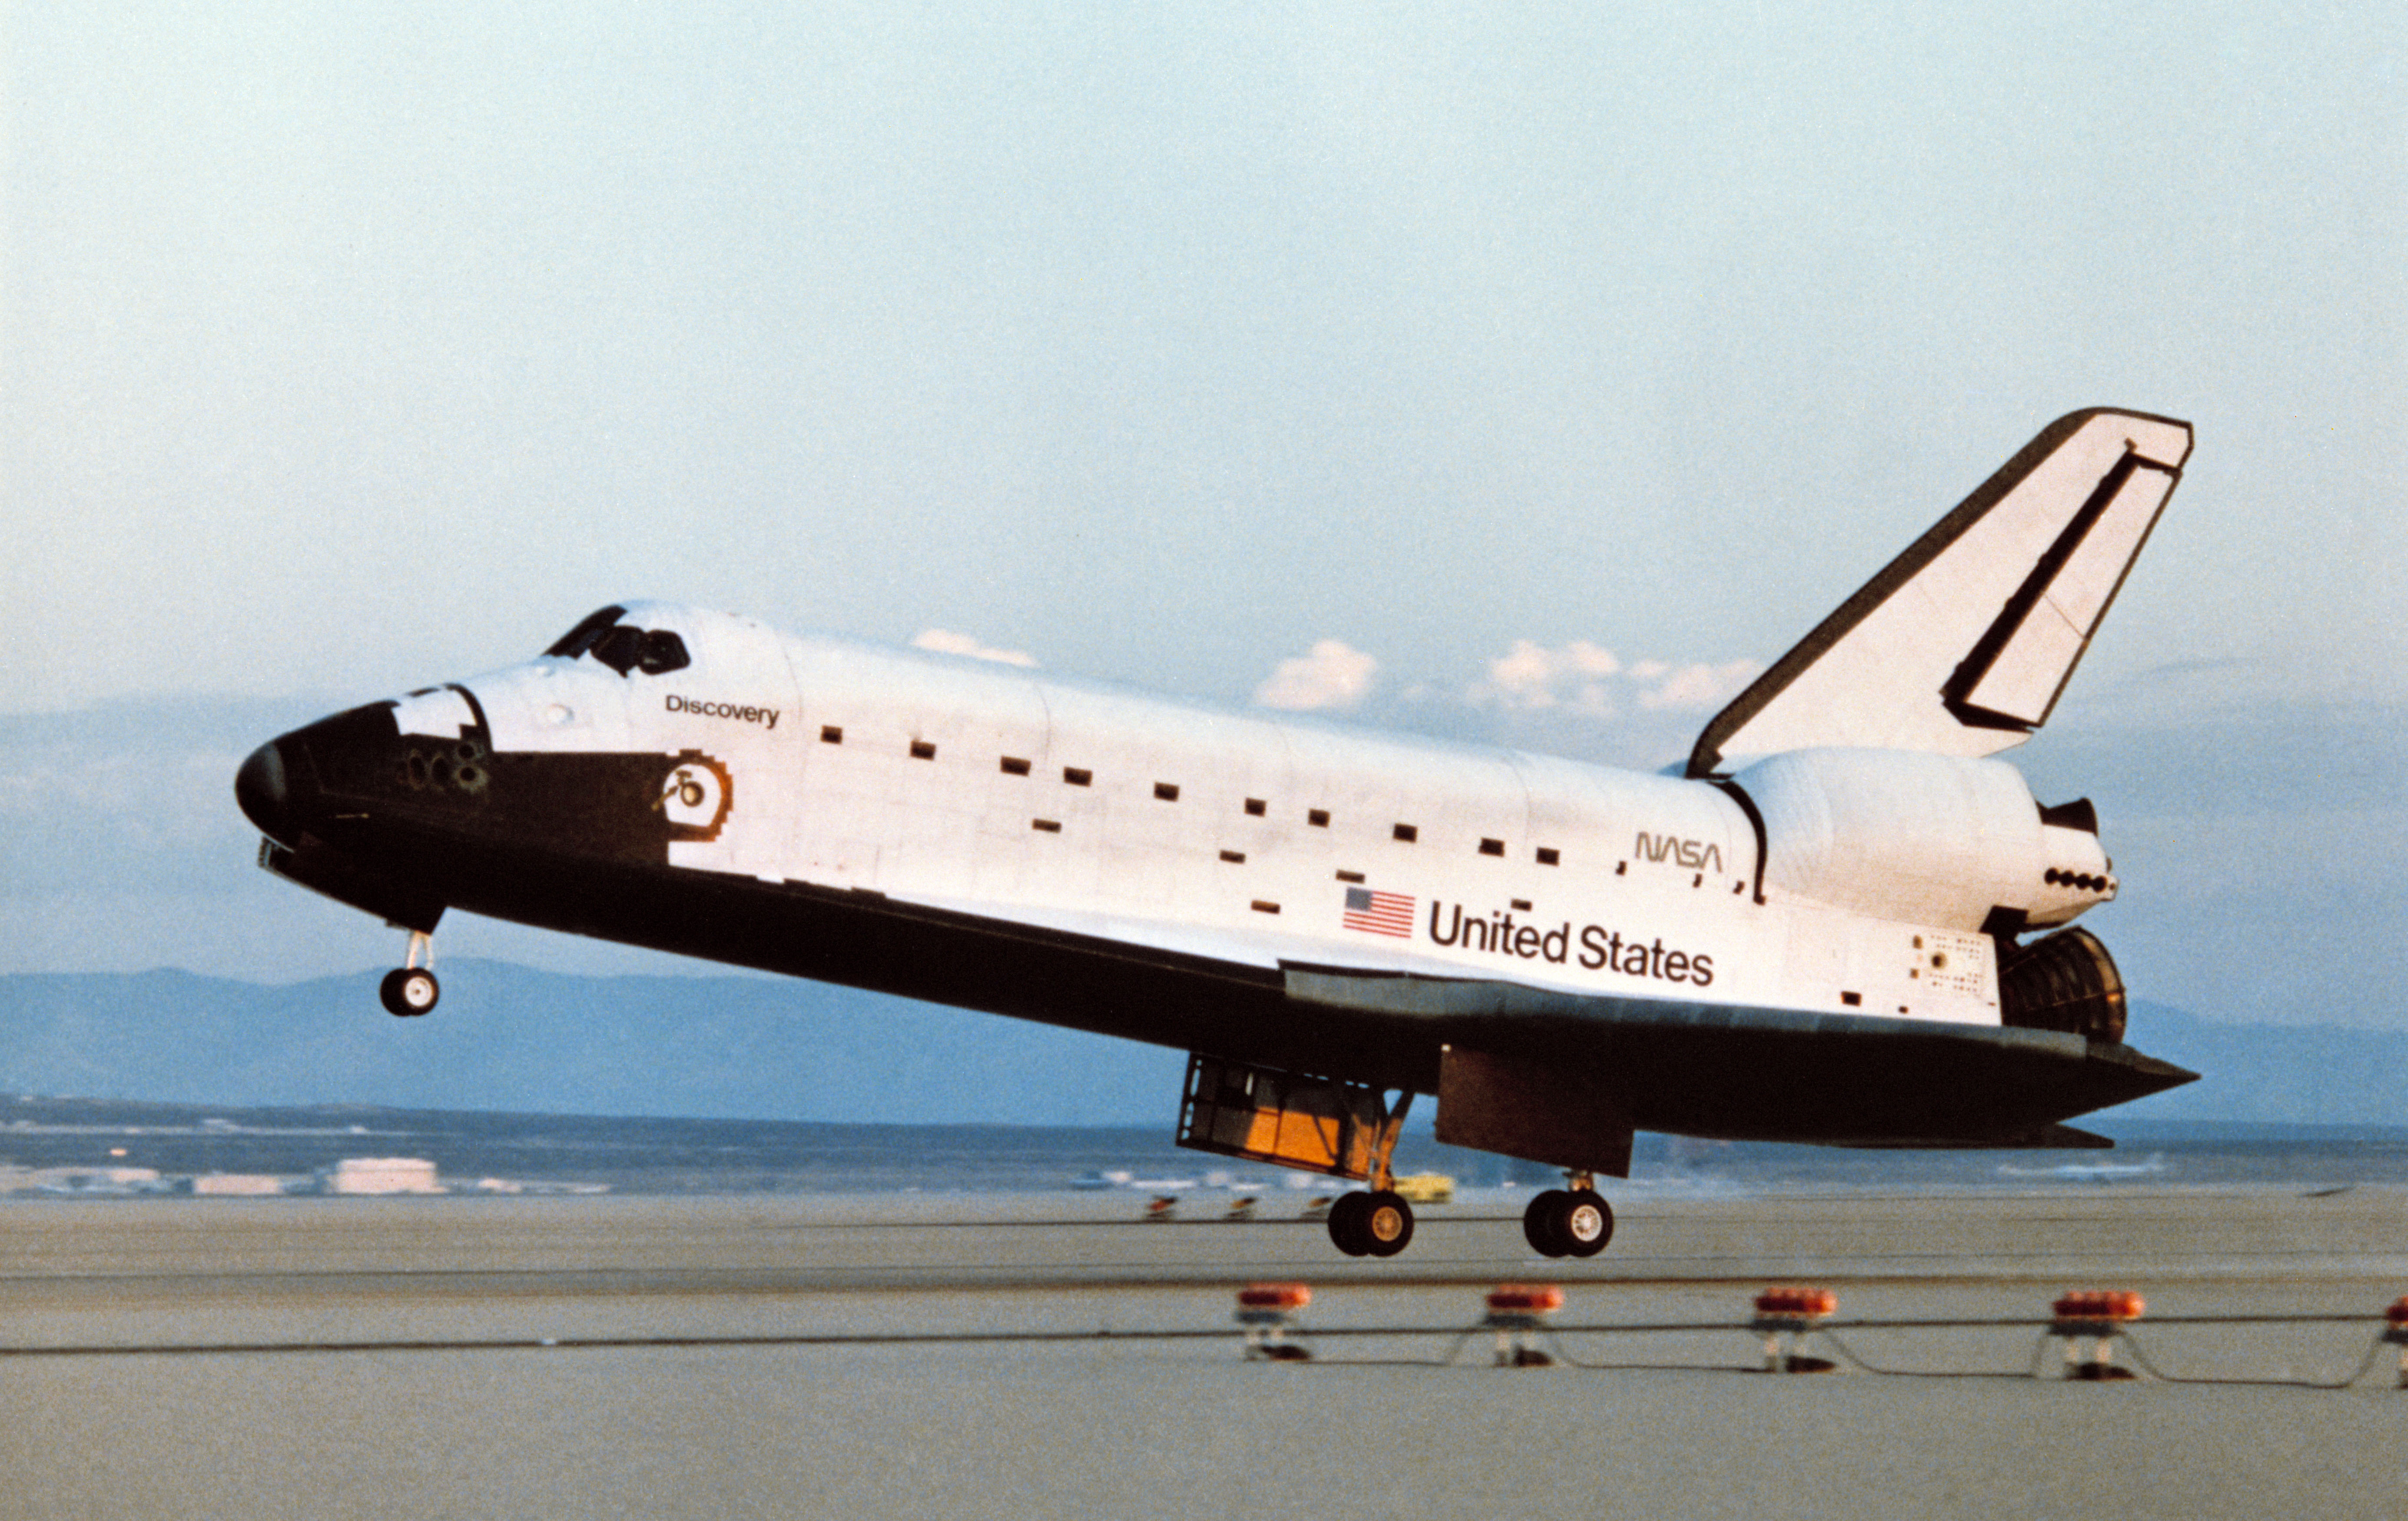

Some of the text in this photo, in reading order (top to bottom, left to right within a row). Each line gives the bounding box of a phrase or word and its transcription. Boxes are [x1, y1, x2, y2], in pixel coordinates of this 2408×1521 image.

[666, 695, 779, 729] Discovery
[1635, 831, 1722, 873] NASA
[1430, 900, 1714, 987] United States
